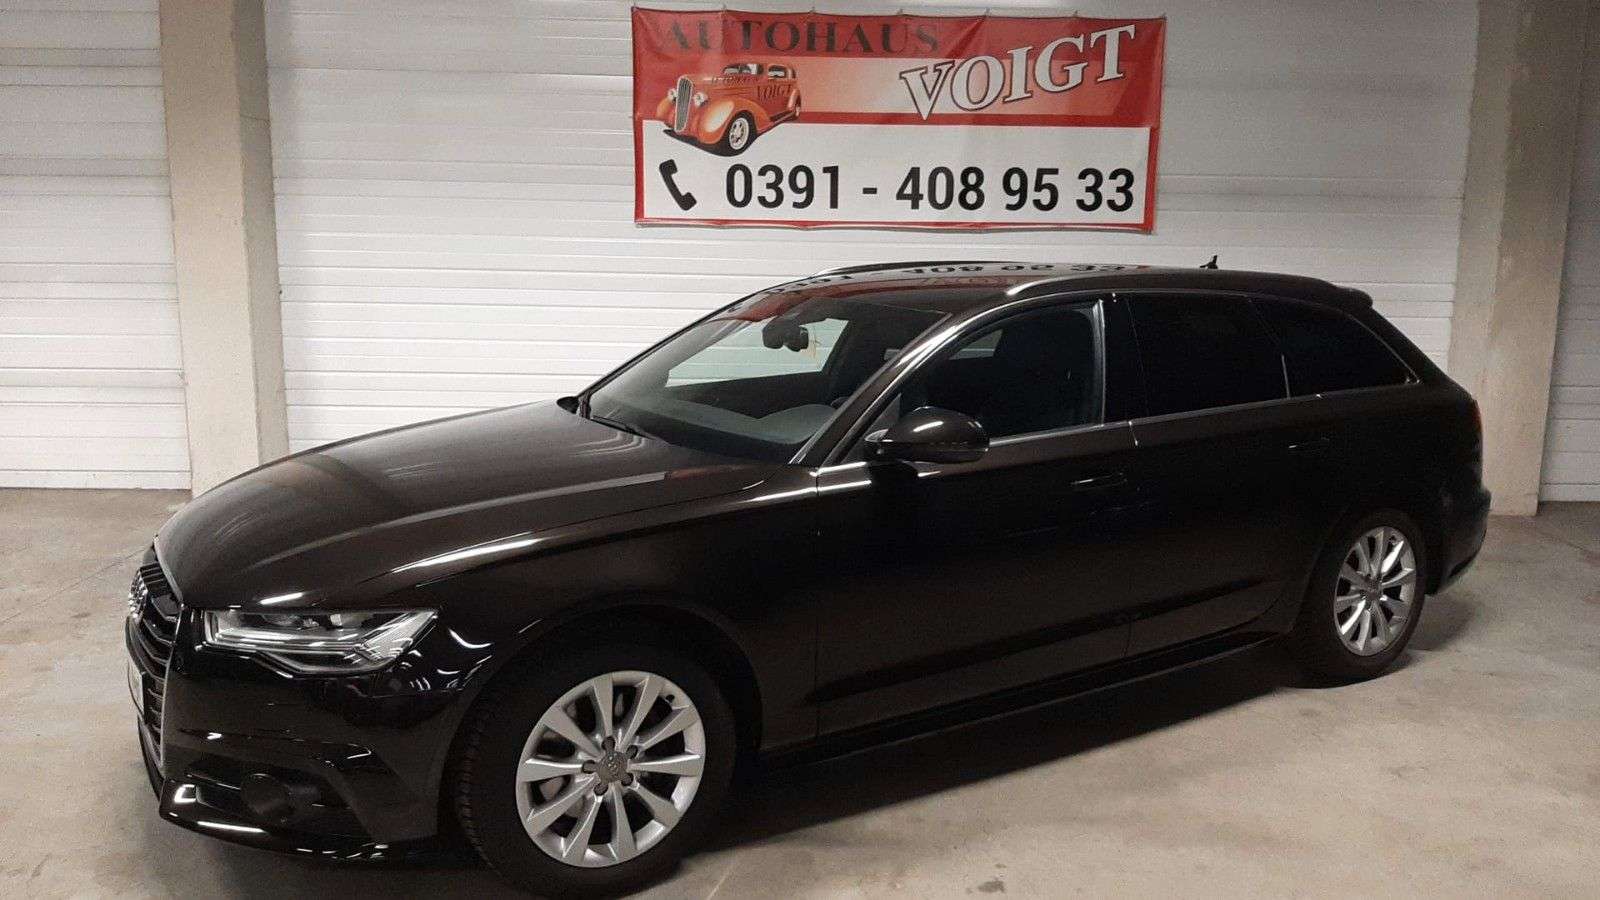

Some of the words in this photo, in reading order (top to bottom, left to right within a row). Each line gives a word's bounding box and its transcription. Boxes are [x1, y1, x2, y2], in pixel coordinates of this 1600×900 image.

[661, 20, 939, 53] AUTOHAUS
[900, 25, 1135, 120] VOIGT
[726, 164, 839, 209] 0391
[896, 166, 985, 211] 408
[1002, 167, 1059, 212] 95
[1076, 168, 1135, 212] 33
